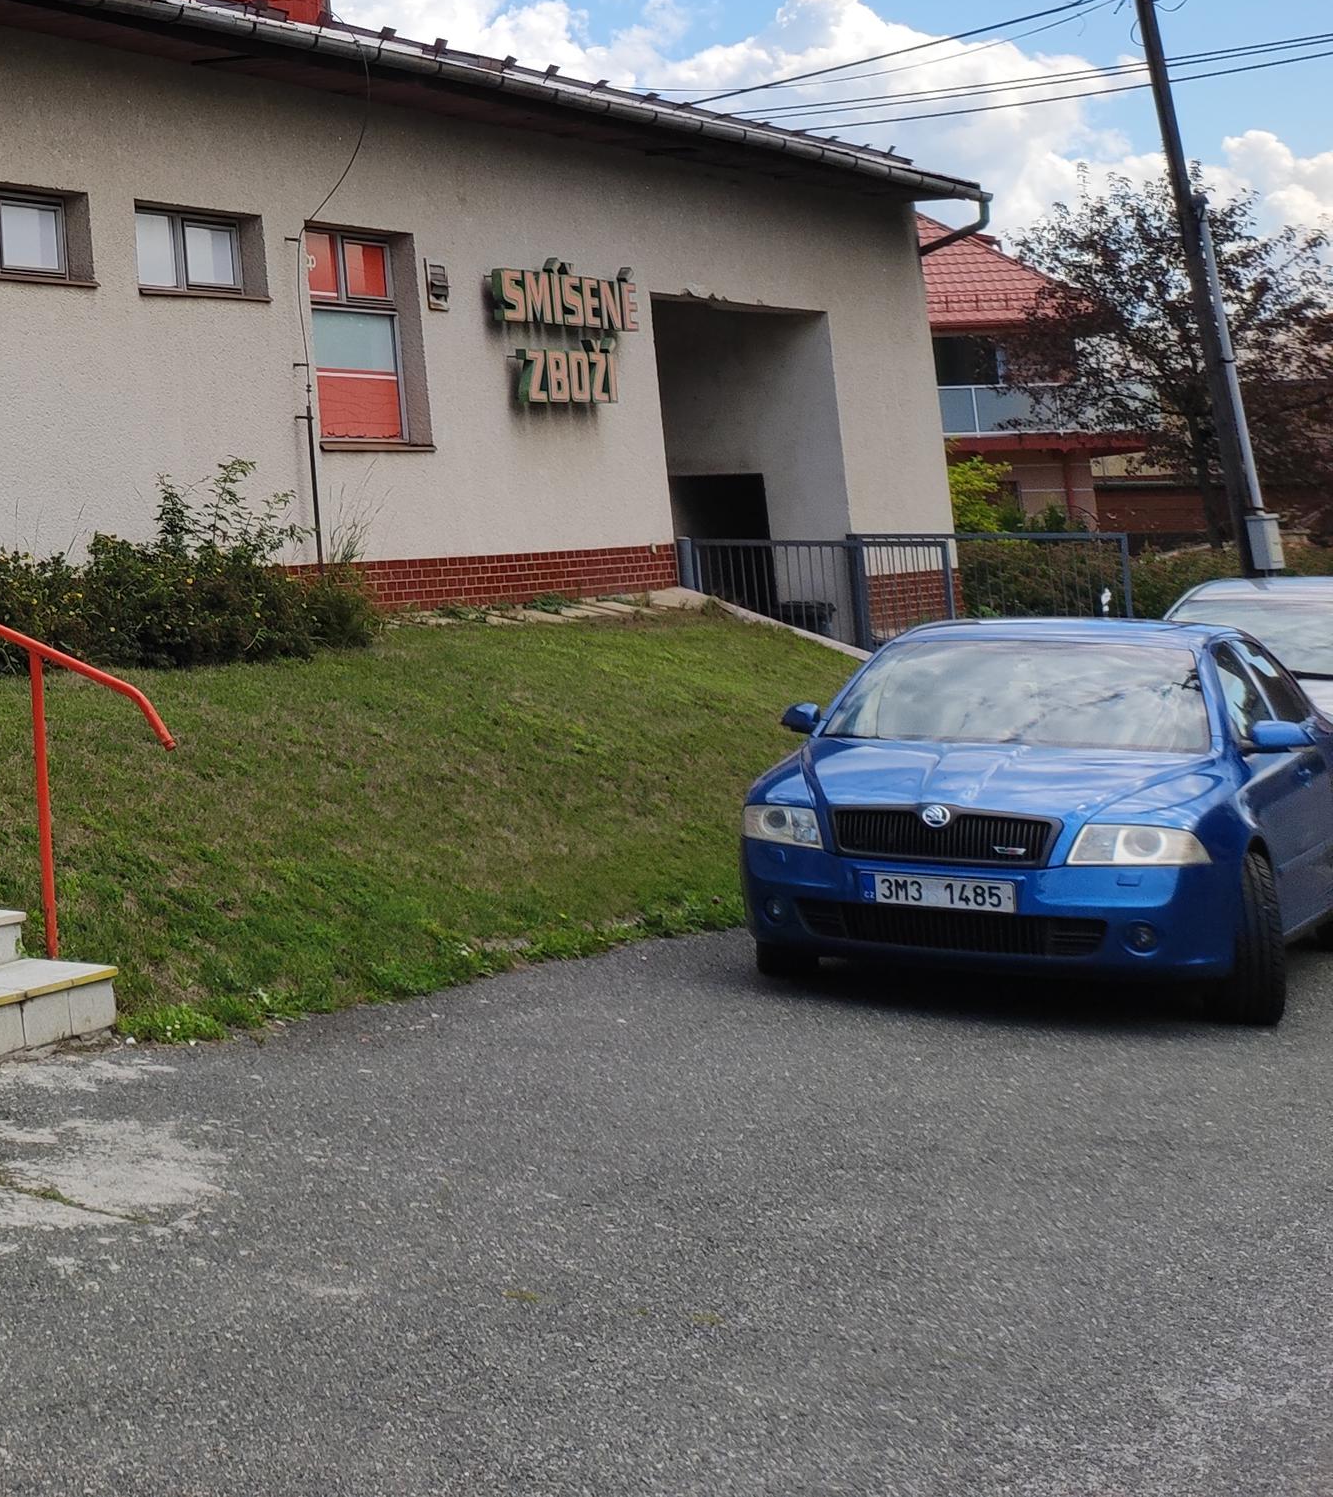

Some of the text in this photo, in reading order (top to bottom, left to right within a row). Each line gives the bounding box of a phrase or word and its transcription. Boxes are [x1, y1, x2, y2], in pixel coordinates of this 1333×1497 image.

[496, 258, 638, 332] SMÍŠENÉ
[521, 338, 618, 403] ZBOŽÍ
[863, 878, 1002, 908] CZ 3M3 1485
